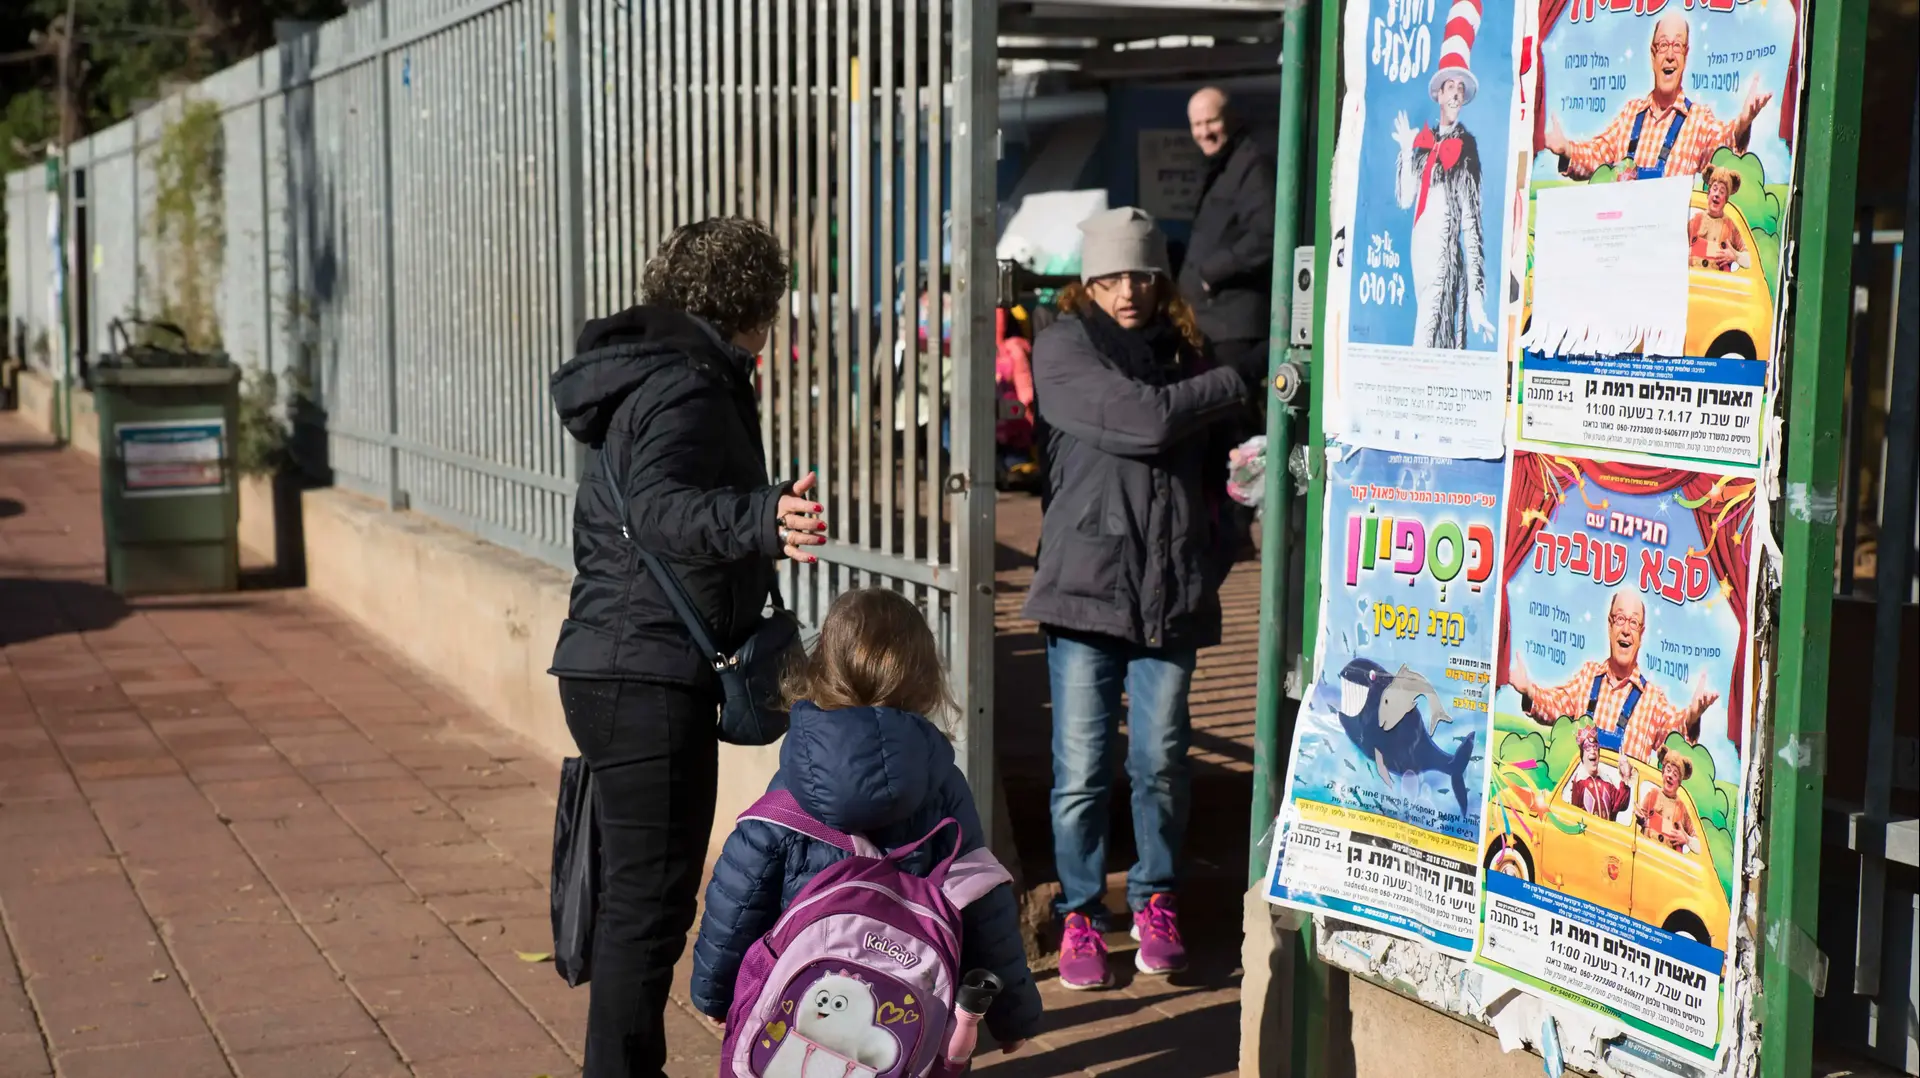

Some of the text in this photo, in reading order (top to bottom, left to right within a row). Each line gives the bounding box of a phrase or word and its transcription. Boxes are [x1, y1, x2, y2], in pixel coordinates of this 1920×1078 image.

[1372, 17, 1430, 83] תעלול
[1746, 44, 1776, 61] ספורים
[1590, 52, 1609, 68] המלך
[1707, 53, 1728, 67] המלך
[1590, 73, 1626, 90] טובי דובי
[1692, 70, 1739, 92] מסיבה ביער
[1586, 96, 1605, 113] ספורי
[1367, 245, 1381, 268] של
[1360, 272, 1385, 305] סוס
[1427, 385, 1457, 398] גבעתיים
[1461, 389, 1492, 401] תיאטרון
[1527, 387, 1573, 402] 1+1 מתנה
[1585, 380, 1597, 397] גן
[1602, 381, 1633, 397] רמת
[1639, 382, 1691, 403] היהלום
[1697, 388, 1753, 407] תאטרון
[1586, 403, 1615, 416] 11:00
[1619, 405, 1653, 419] בשעה
[1658, 409, 1692, 423] 7.1.17
[1583, 420, 1598, 428] בראבו
[1601, 422, 1613, 430] באתר
[1700, 412, 1730, 426] שבת
[1735, 415, 1749, 428] יום
[1617, 425, 1653, 435] 050-7273300
[1655, 427, 1689, 437] 03-5406777
[1691, 430, 1706, 440] טלפון
[1709, 432, 1729, 441] במשרד
[1351, 485, 1495, 507] עפ"י ספרו רב המכר של פאול קור
[1586, 511, 1668, 546] חגיגה עם
[1533, 530, 1710, 605] סבא טוביה
[1552, 606, 1570, 624] המלך
[1551, 628, 1585, 650] טובי דובי
[1546, 648, 1566, 666] ספורי
[1660, 639, 1721, 658] ספורים כיד המלך
[1445, 668, 1476, 682] קורקוס
[1646, 653, 1688, 684] מסיבה ביער
[1453, 697, 1476, 710] מלכה
[1426, 819, 1473, 838] רגיש ויפה. לא
[1290, 832, 1342, 852] 1+1 מתנה
[1348, 846, 1362, 863] גן
[1369, 851, 1400, 871] רמת
[1405, 860, 1440, 886] היהלום
[1441, 859, 1460, 870] חנוכה
[1346, 867, 1379, 882] 10:30
[1382, 875, 1412, 892] בשעה
[1444, 875, 1476, 896] טרון
[1414, 884, 1446, 906] 30.12.16
[1449, 898, 1475, 914] שישי
[1451, 914, 1472, 925] במשרד
[1490, 910, 1518, 928] מתנה
[1550, 918, 1562, 936] גן
[1523, 921, 1539, 936] 1+1
[1568, 924, 1599, 948] רמת
[1604, 937, 1650, 969] היהלום
[1546, 956, 1561, 968] בראבו
[1563, 962, 1577, 974] באתר
[1551, 941, 1702, 1009] יום שבת 7.1.17 בשעה 11:00
[1580, 969, 1616, 988] 050-7273300
[1655, 958, 1706, 991] תאטרון
[1646, 996, 1660, 1007] טלפון
[1662, 1004, 1681, 1016] במשרד
[1683, 1013, 1705, 1025] כרטיסים
